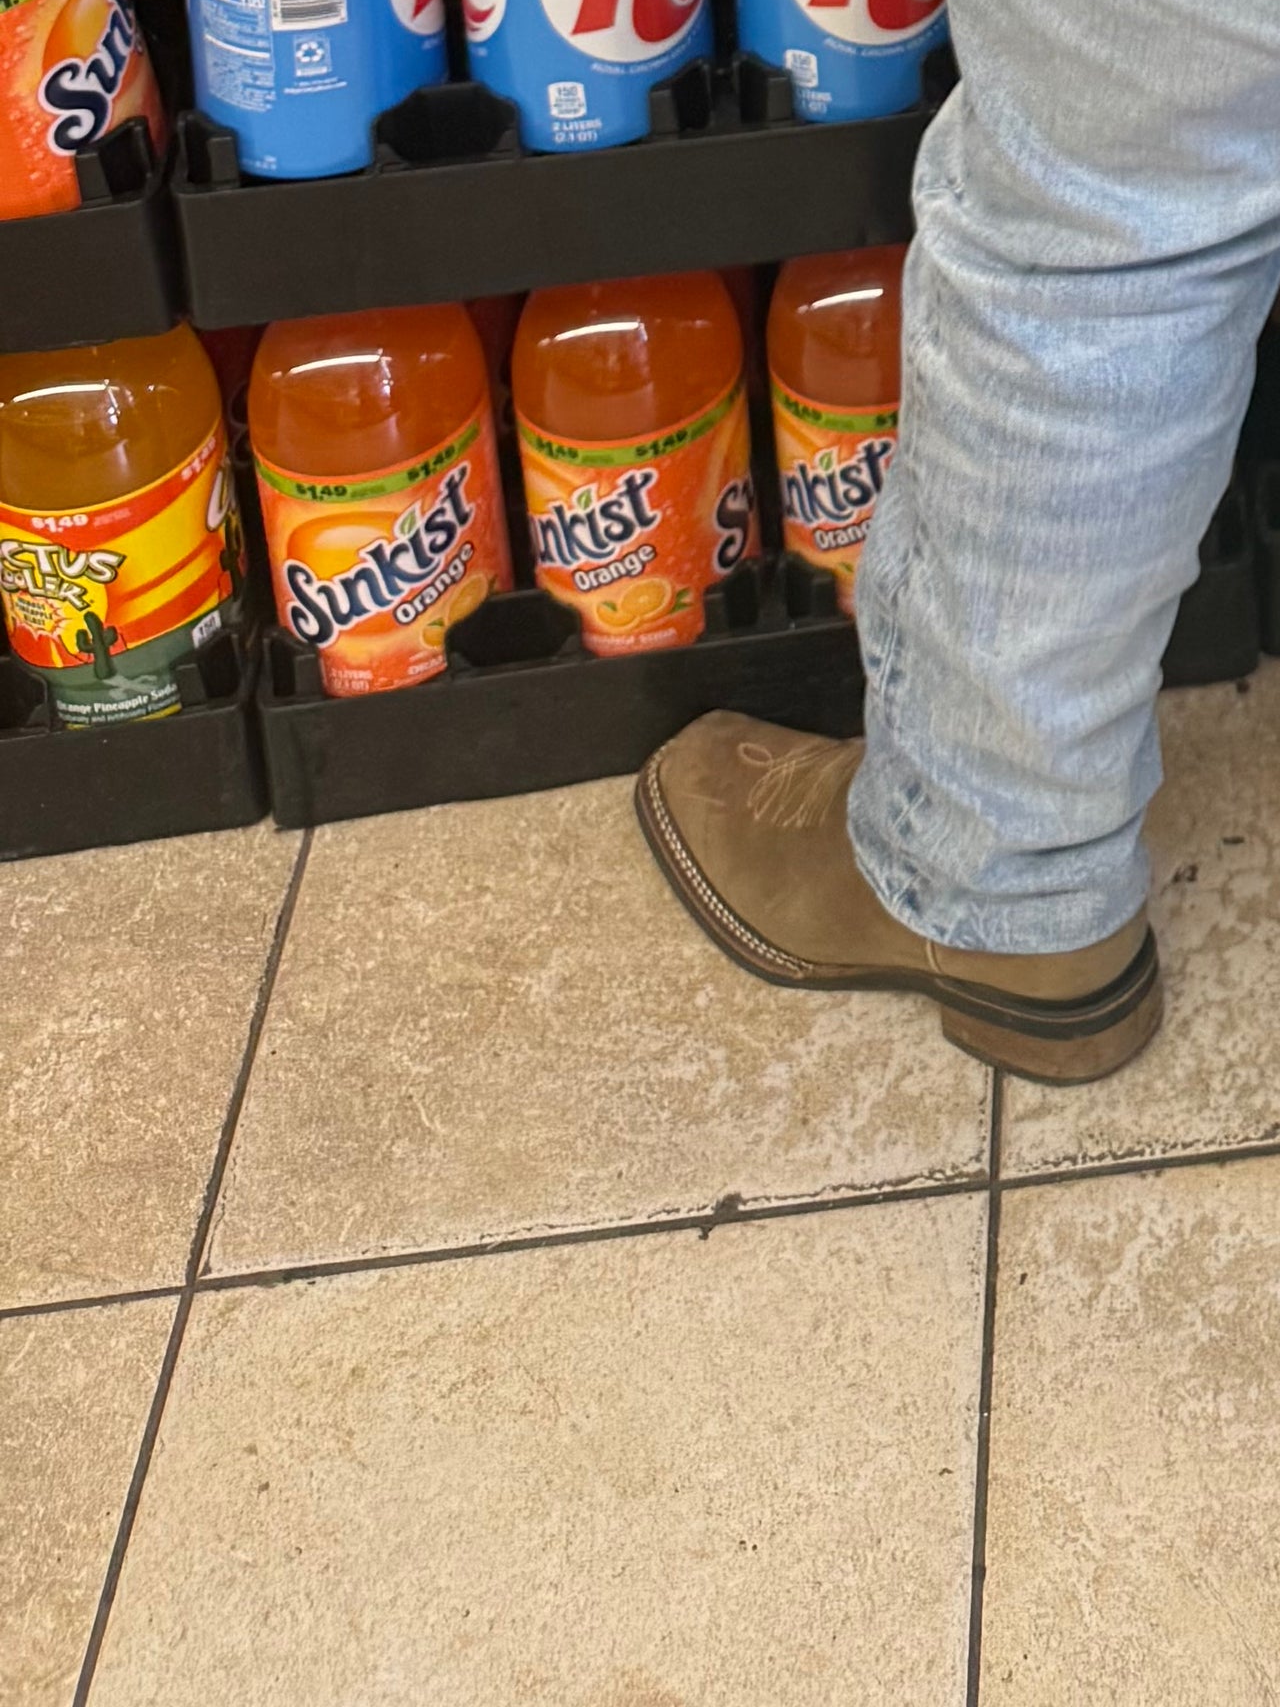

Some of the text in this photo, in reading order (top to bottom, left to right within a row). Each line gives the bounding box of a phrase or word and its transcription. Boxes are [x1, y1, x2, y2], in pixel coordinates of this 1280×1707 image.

[635, 428, 688, 459] $1.49
[405, 443, 458, 485] $1.49
[295, 483, 348, 503] $1.49
[31, 513, 89, 534] $1.49
[284, 463, 474, 649] Sunkist
[573, 543, 659, 592] Orange
[394, 541, 476, 626] Orange
[93, 693, 149, 714] Pineapple
